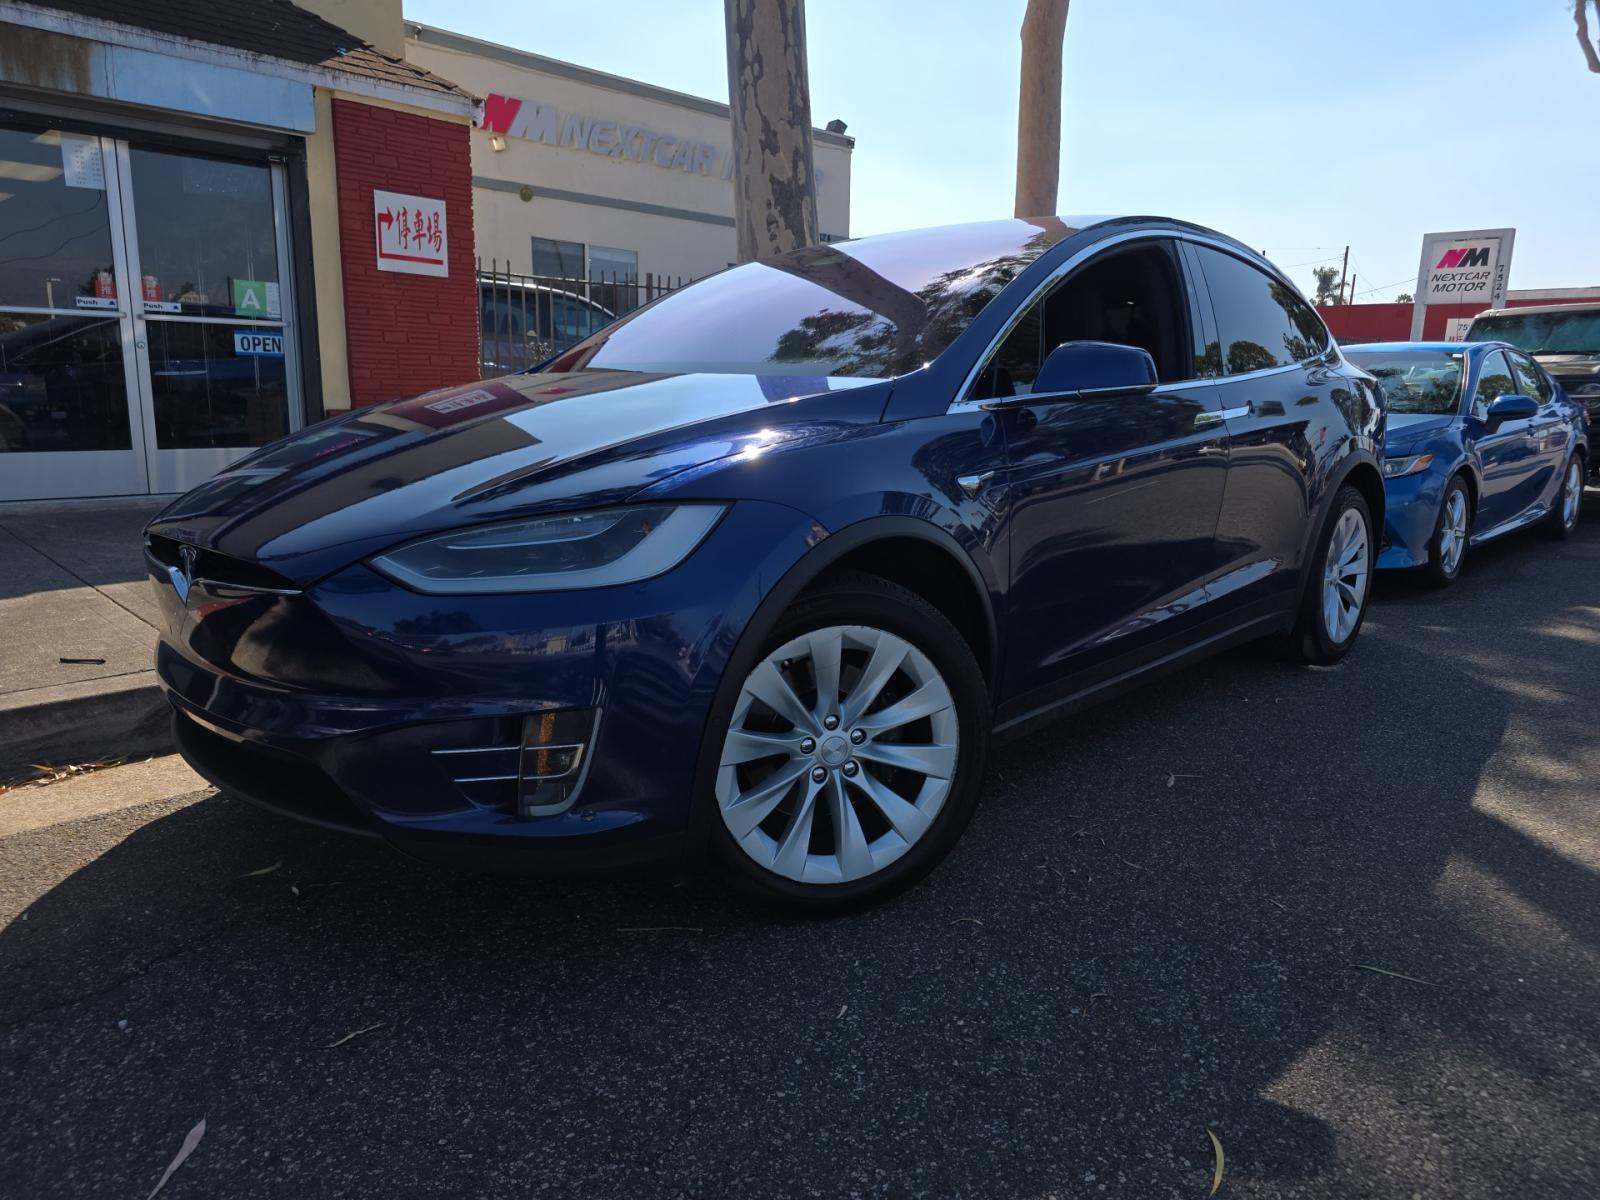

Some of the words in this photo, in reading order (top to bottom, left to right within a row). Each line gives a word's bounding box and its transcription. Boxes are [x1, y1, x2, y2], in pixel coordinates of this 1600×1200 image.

[561, 112, 720, 178] NEXTCAR
[396, 206, 442, 253] 停車場
[1436, 247, 1490, 269] NM
[1431, 271, 1490, 282] NEXTCAR
[1432, 281, 1486, 293] MOTOR
[143, 302, 164, 310] Push
[241, 288, 261, 310] A
[240, 336, 282, 352] OPEN
